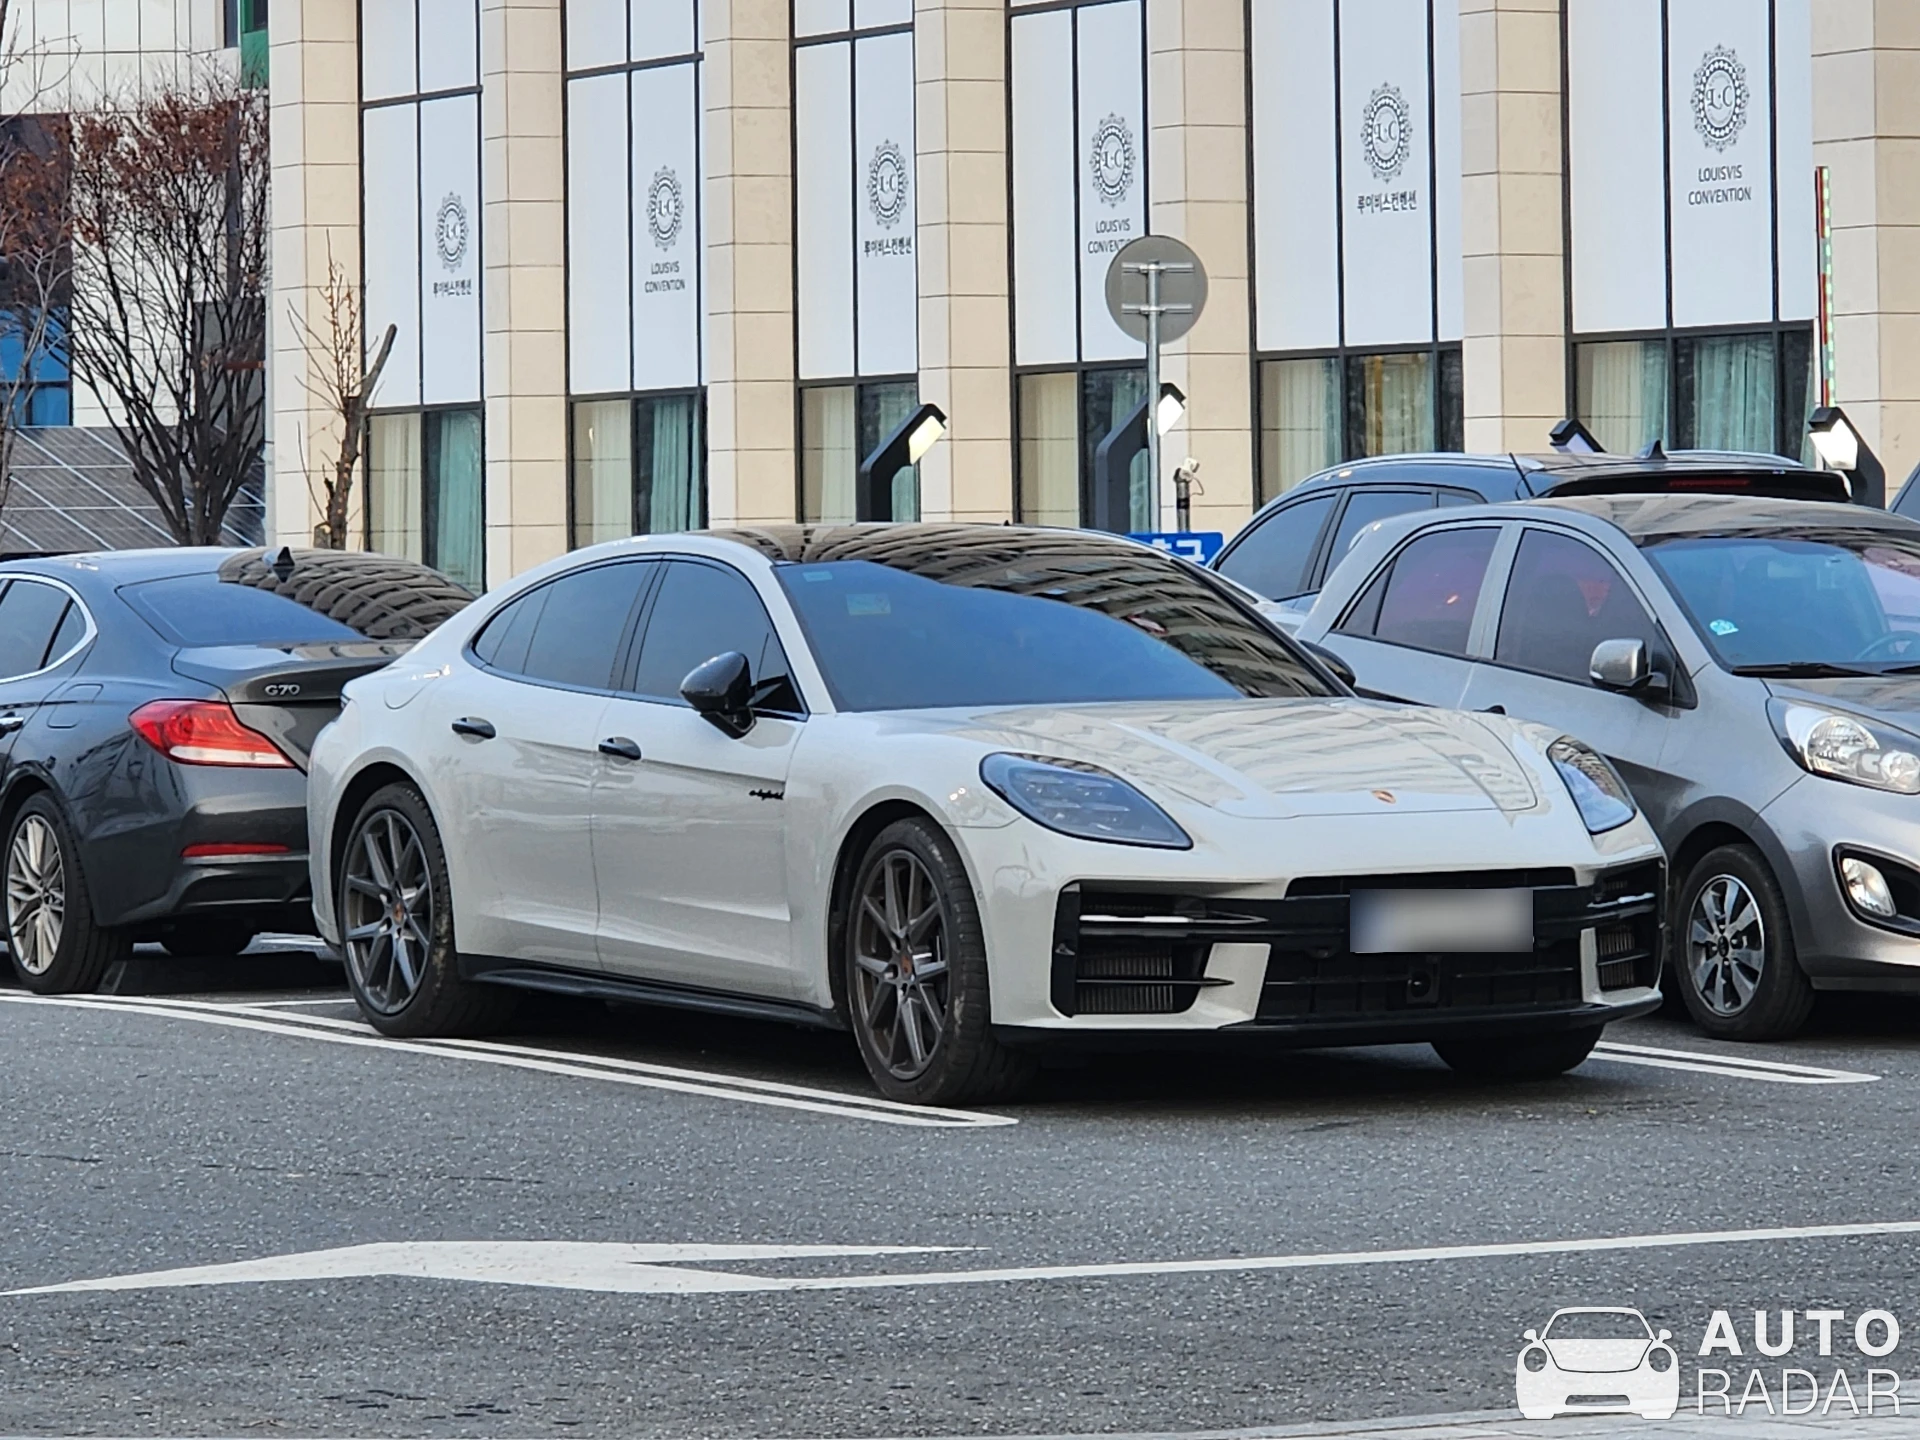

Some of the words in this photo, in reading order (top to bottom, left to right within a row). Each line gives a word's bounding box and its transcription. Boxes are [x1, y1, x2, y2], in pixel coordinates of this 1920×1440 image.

[1698, 165, 1743, 182] LOUISVIS
[1357, 190, 1417, 214] 루이비스컨벤션
[1688, 187, 1752, 206] CONVENTION
[1095, 218, 1131, 234] LOUISVIS
[650, 260, 680, 275] LOUISVIS
[644, 279, 686, 293] CONVENTION
[265, 684, 301, 696] G70
